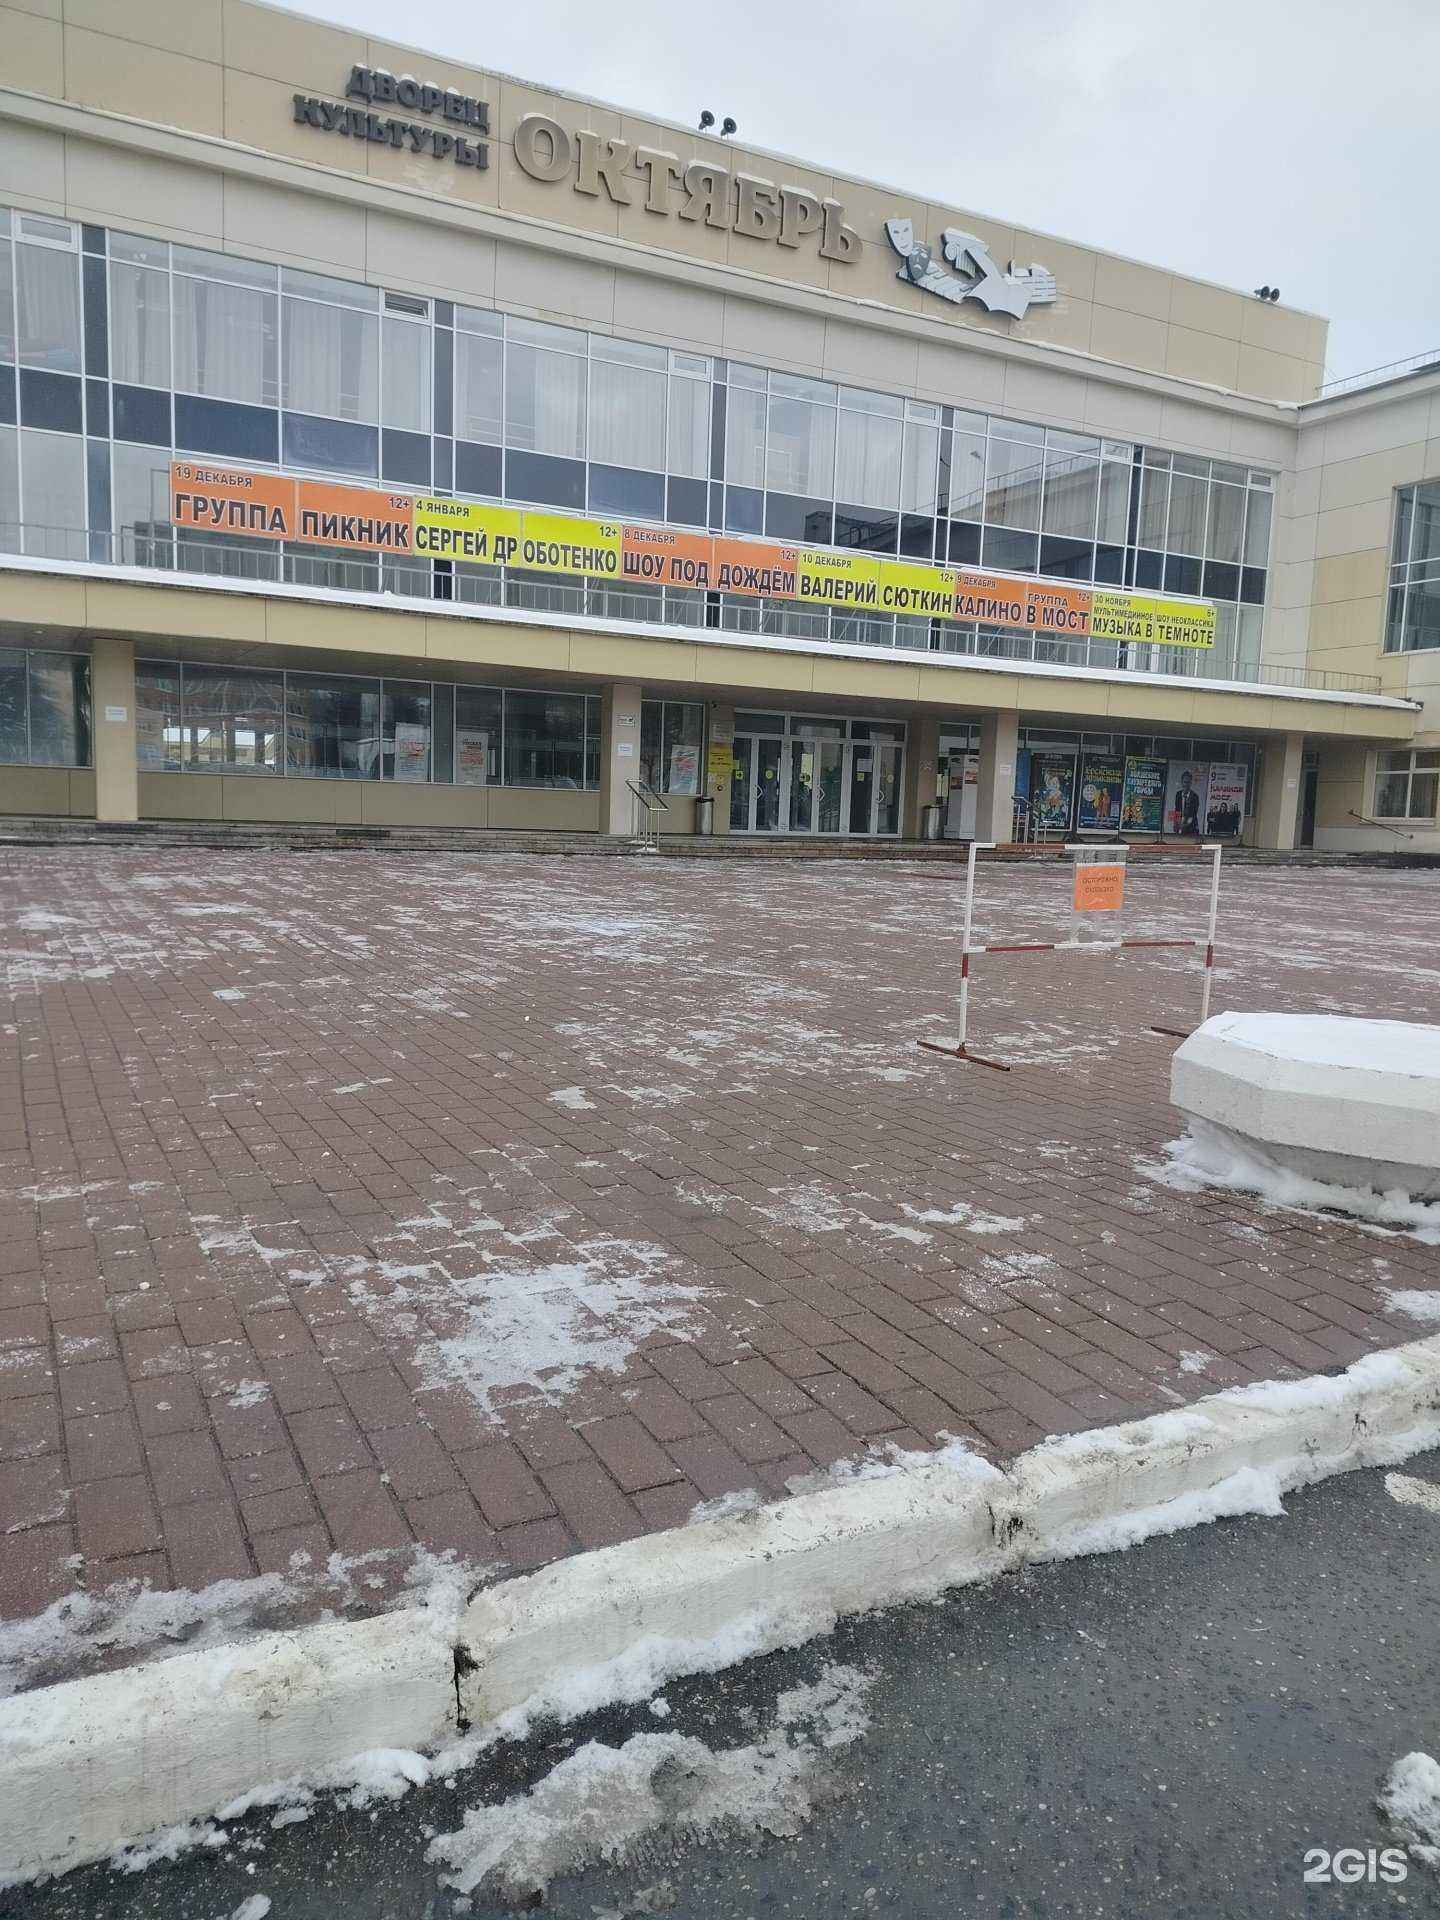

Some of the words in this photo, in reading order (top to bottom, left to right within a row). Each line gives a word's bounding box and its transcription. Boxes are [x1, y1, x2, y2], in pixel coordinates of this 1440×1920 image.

[345, 64, 490, 134] ДВОРЕЦ
[293, 93, 489, 169] КУЛЬТУРЫ
[514, 112, 864, 263] ОКТЯБРЬ
[176, 466, 191, 480] 19
[195, 470, 252, 488] ДЕКАБРЯ
[389, 497, 410, 509] 12+
[416, 500, 423, 511] 4
[427, 502, 470, 517] ЯНВАРЯ
[176, 493, 287, 533] ГРУППА
[302, 510, 409, 548] ПИКНИК
[599, 526, 618, 538] 12+
[624, 528, 631, 539] 8
[633, 532, 675, 544] ДЕКАБРЯ
[416, 525, 487, 557] СЕРГЕЙ
[780, 550, 796, 560] 12+
[803, 553, 813, 564] 10
[815, 556, 852, 568] ДЕКАБРЯ
[624, 551, 665, 578] ШОУ
[671, 557, 709, 587] ПОД
[718, 563, 796, 594] ДОЖДЁМ
[940, 573, 954, 583] 12+
[957, 575, 962, 584] 9
[964, 577, 996, 589] ДЕКАБРЯ
[800, 574, 877, 604] ВАЛЕРИЙ
[883, 585, 951, 614] СЮТКИН
[1028, 593, 1068, 607] ГРУППА
[1105, 596, 1131, 607] НОЯБРЯ
[1042, 606, 1089, 630] МОСТ
[1156, 615, 1169, 624] ШОУ
[1092, 617, 1141, 637] МУЗЫКА
[1146, 623, 1153, 638] В
[1158, 625, 1214, 645] ТЕМНОТЕ
